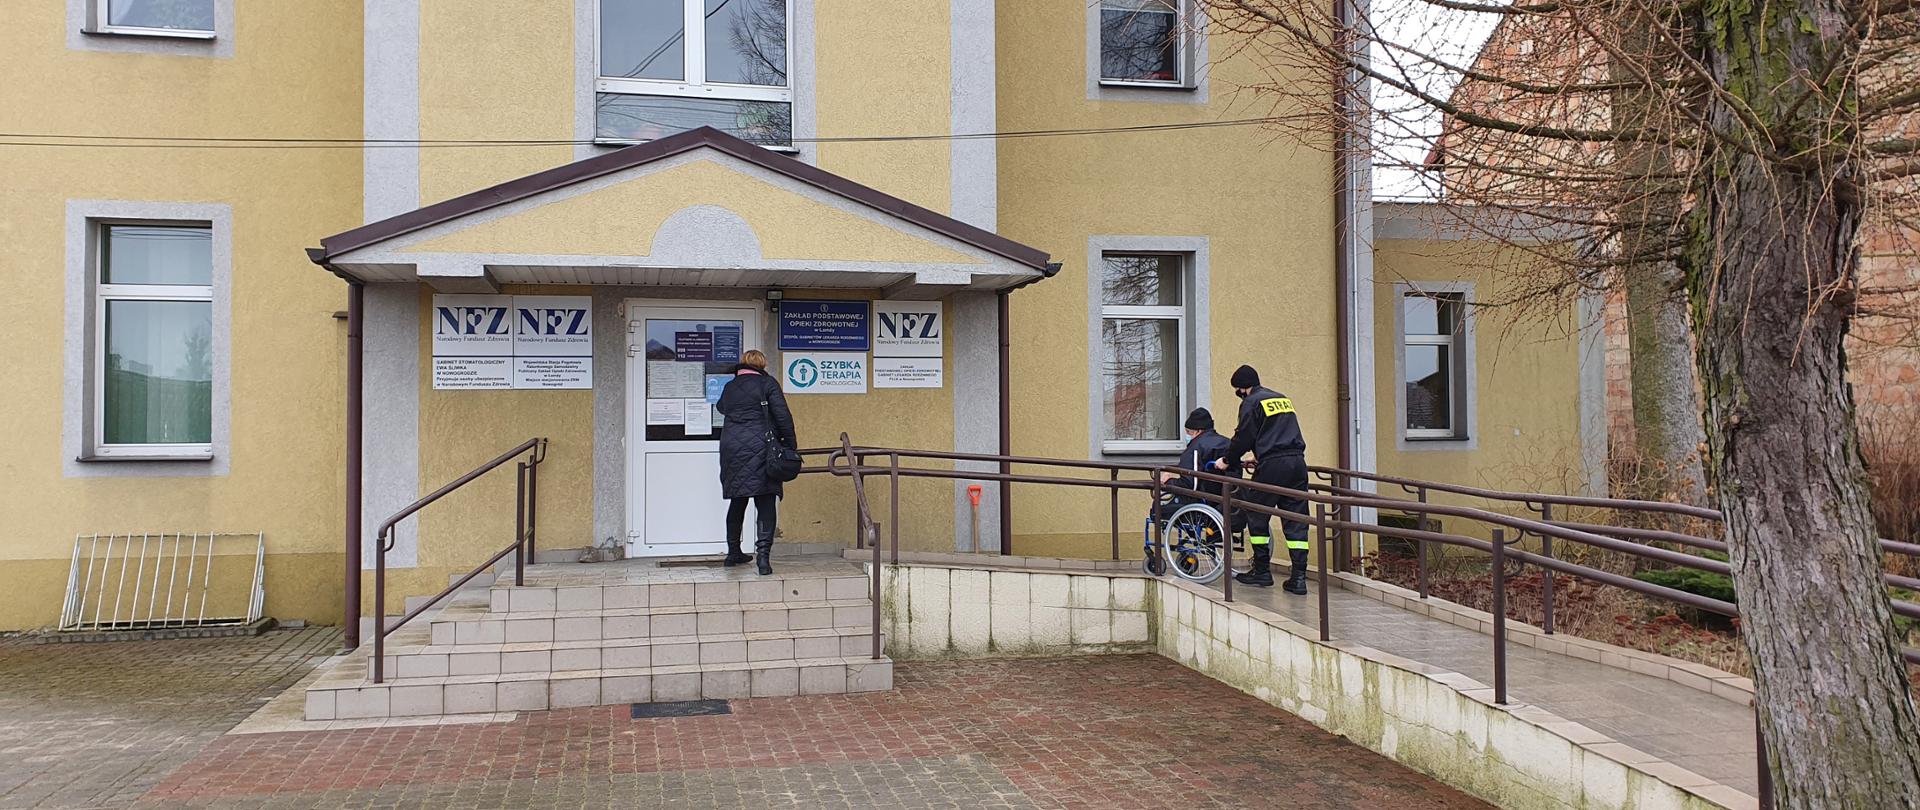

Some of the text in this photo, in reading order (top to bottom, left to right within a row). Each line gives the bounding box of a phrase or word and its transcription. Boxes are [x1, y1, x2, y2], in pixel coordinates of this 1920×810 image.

[436, 306, 510, 336] NFZ
[518, 308, 589, 335] NFZ
[812, 312, 864, 320] PODSTAWOWEJ
[877, 312, 939, 338] NFZ
[820, 361, 861, 369] SZYBKA
[821, 371, 861, 379] TERAPIA
